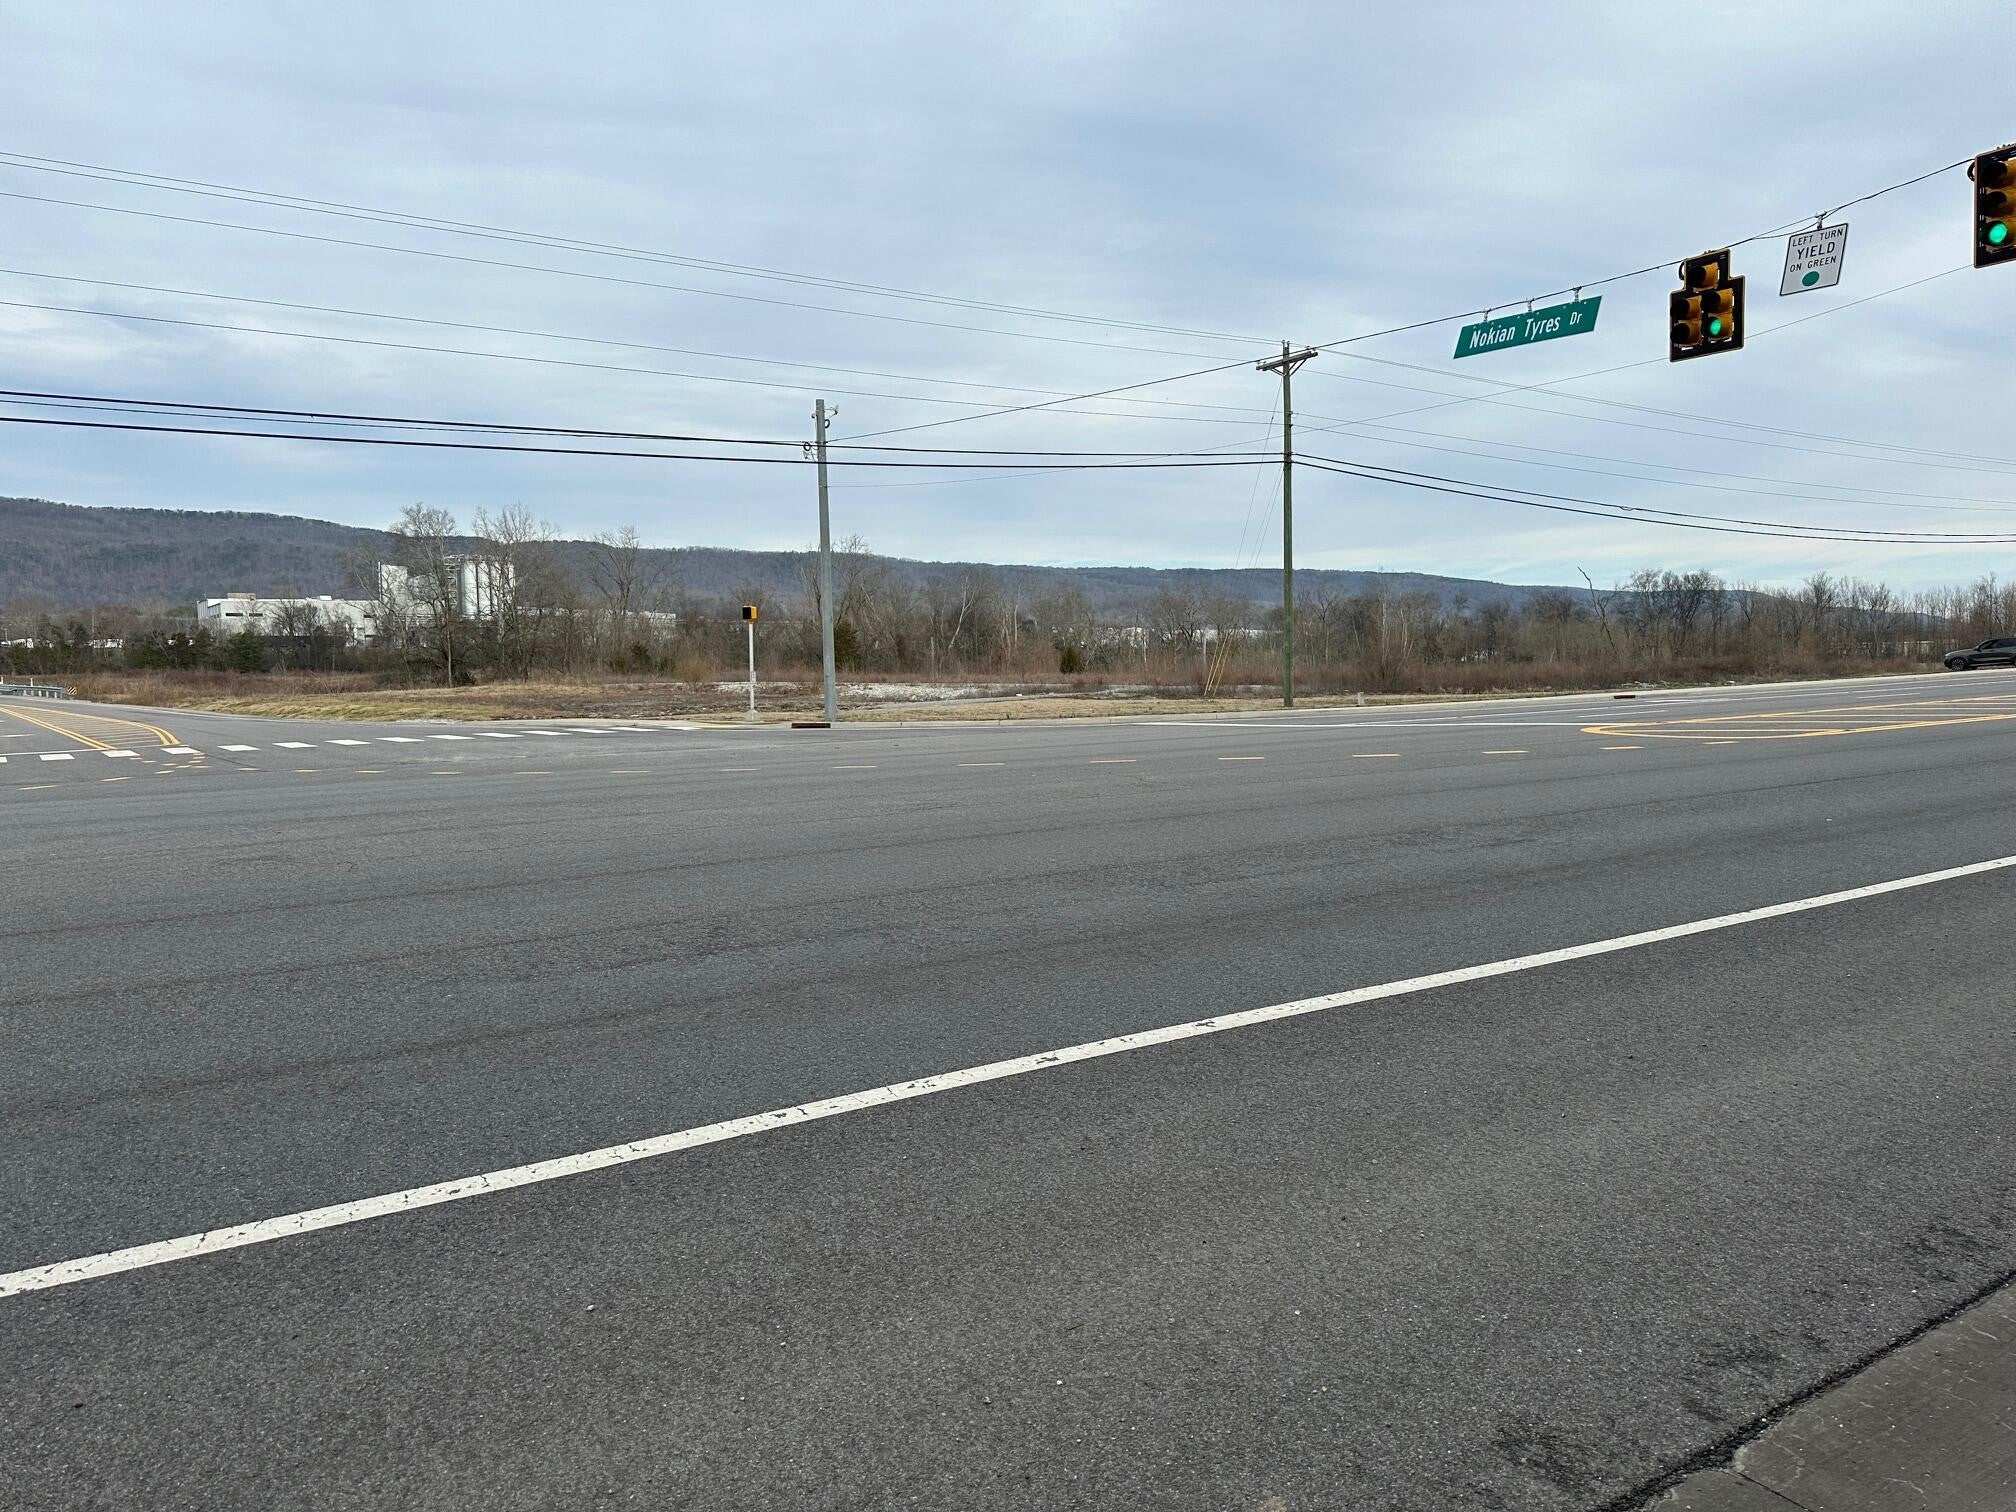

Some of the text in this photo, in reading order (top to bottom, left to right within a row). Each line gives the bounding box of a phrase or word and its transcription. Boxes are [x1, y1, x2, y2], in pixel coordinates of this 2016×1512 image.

[1792, 229, 1843, 247] LEFT TURN
[1797, 242, 1835, 259] YIELD
[1789, 256, 1836, 272] ON GREEN
[1469, 311, 1583, 349] Nokian Tyres Dr
